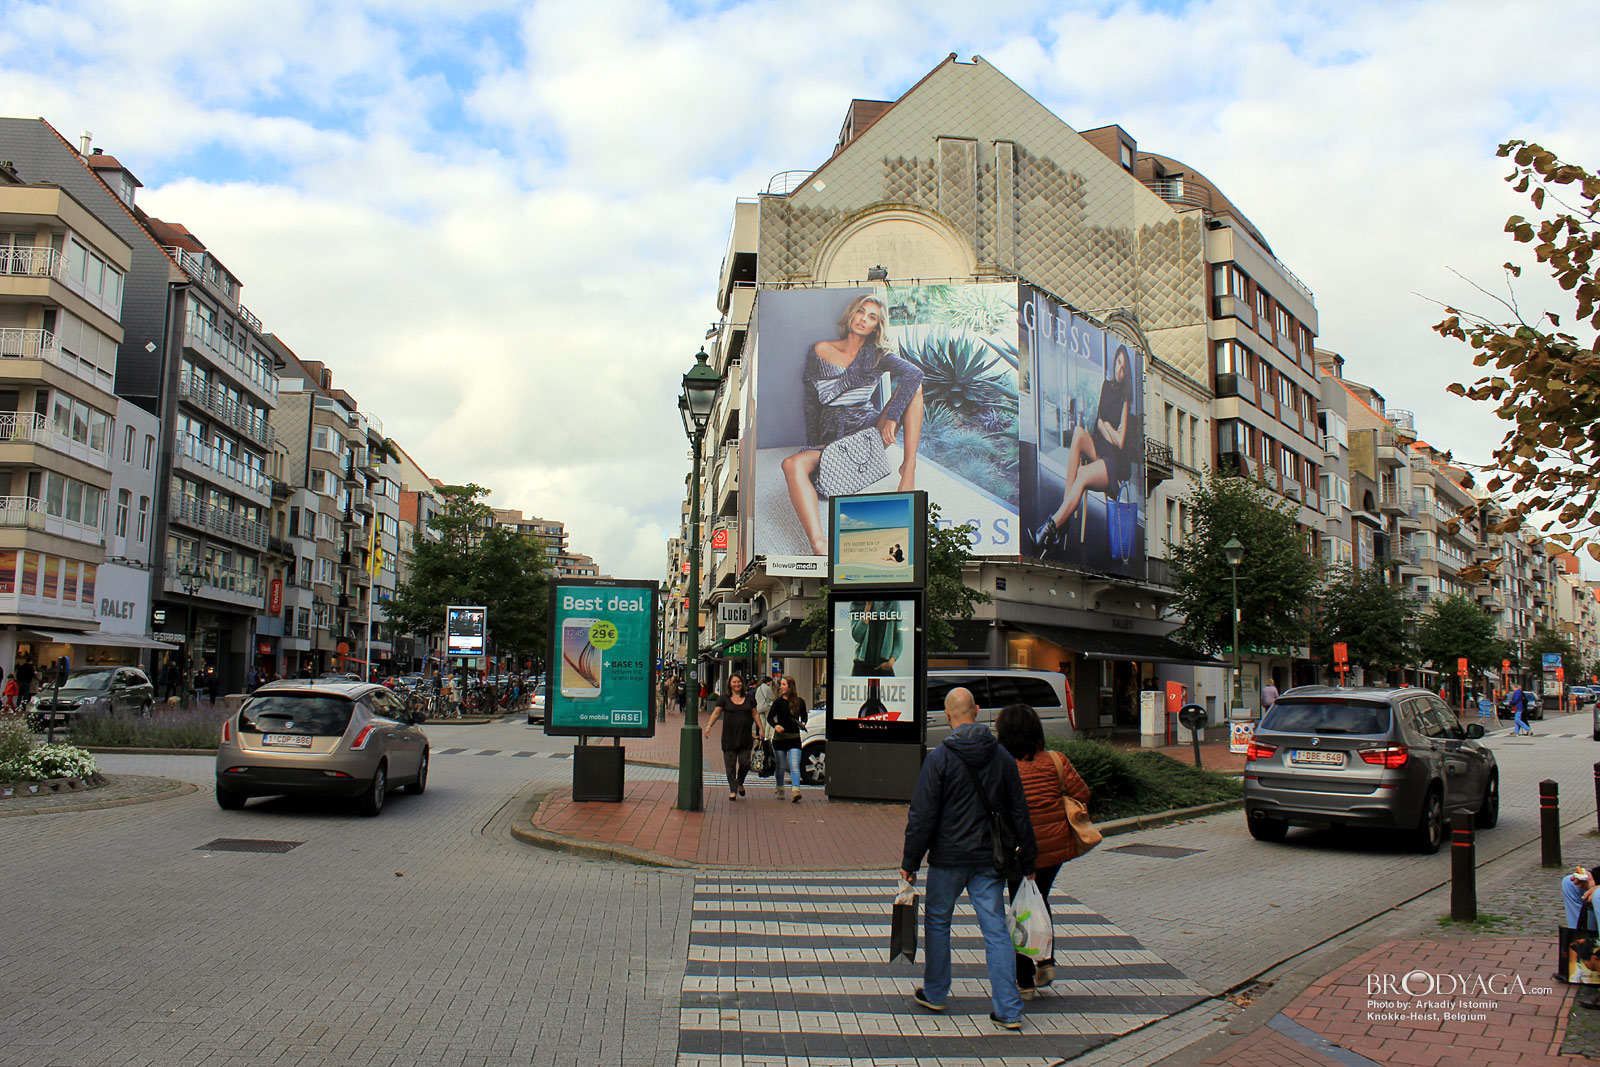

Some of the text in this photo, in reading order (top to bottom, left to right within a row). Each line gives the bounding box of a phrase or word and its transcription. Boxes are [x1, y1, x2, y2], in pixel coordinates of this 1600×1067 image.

[1023, 300, 1091, 359] GUESS
[563, 595, 644, 612] Best deal
[722, 606, 748, 621] Lucia
[849, 611, 909, 621] TERRE BLEUE
[614, 713, 639, 722] BASE
